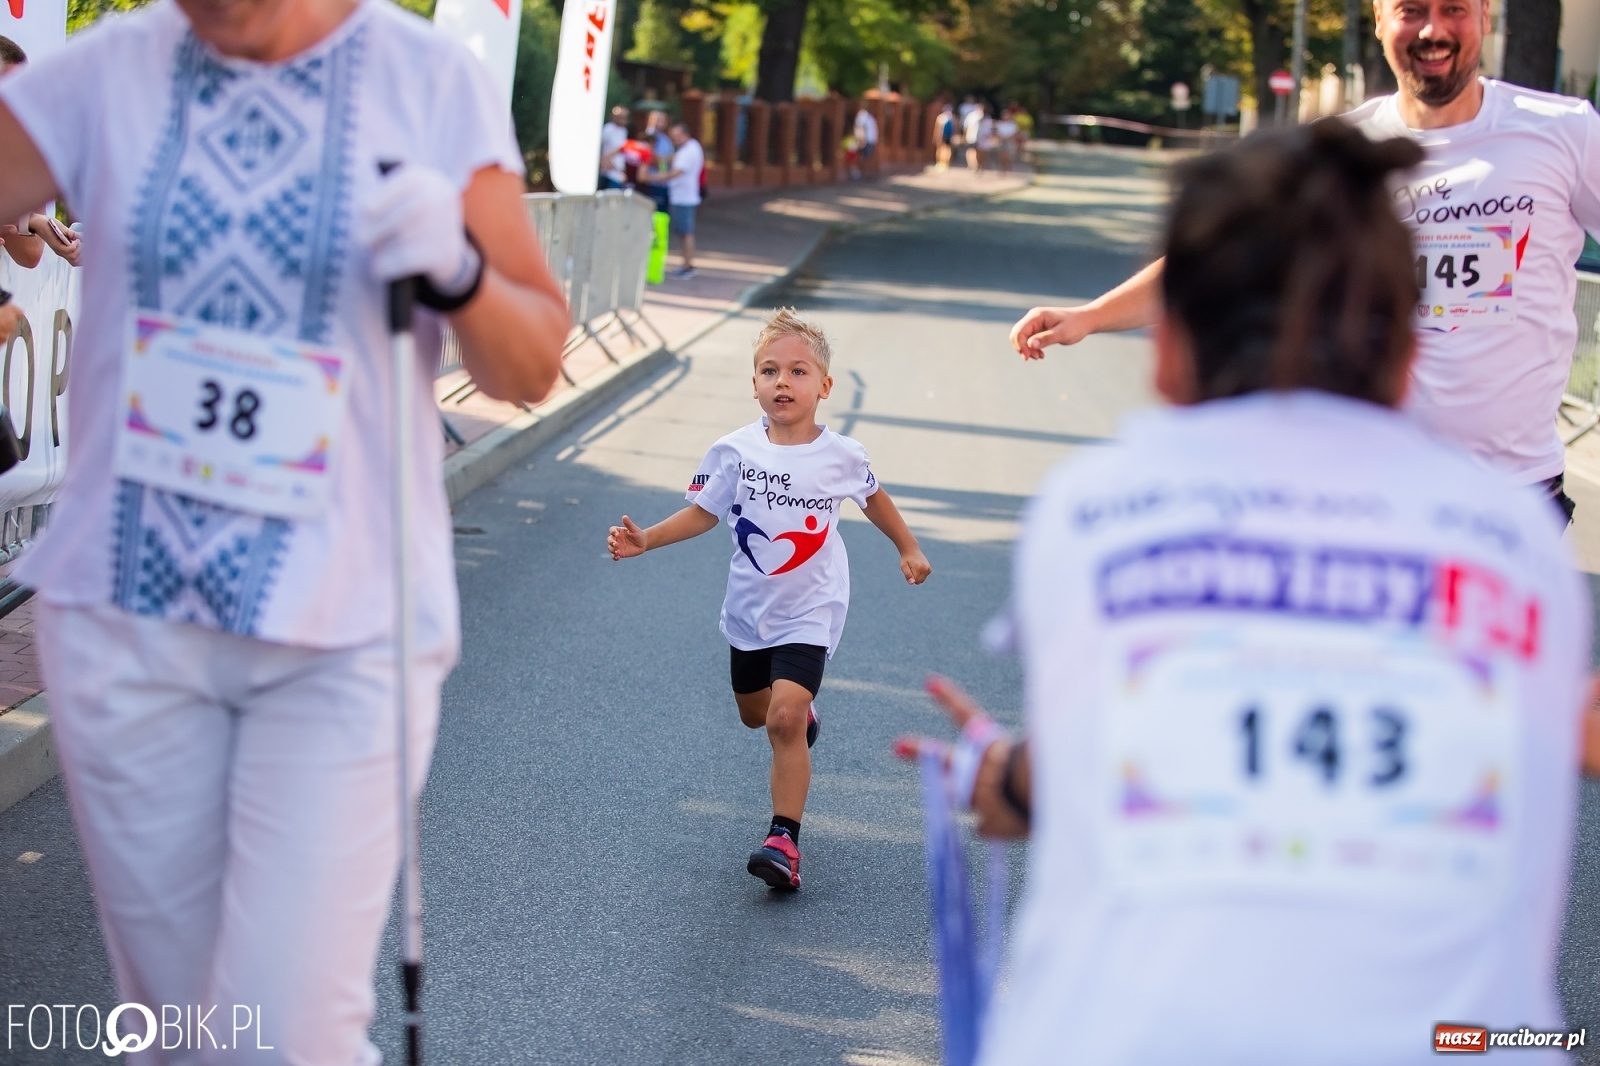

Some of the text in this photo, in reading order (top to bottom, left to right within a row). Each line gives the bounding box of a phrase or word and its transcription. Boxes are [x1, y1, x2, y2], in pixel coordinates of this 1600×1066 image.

[1394, 177, 1452, 221] gnę
[1414, 254, 1480, 288] 145
[195, 380, 260, 440] 38
[746, 486, 833, 514] z pomocą
[1239, 705, 1406, 788] 143
